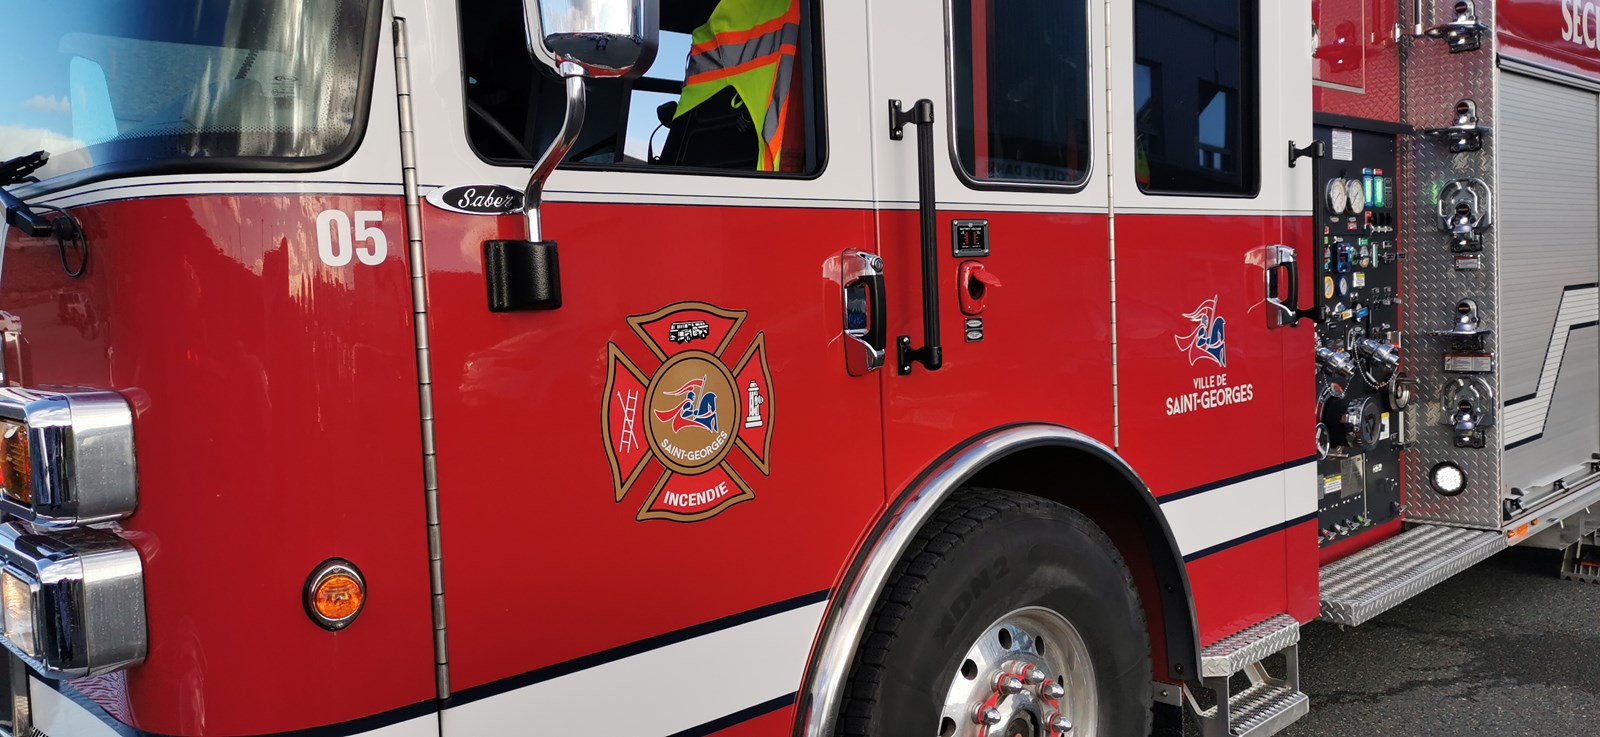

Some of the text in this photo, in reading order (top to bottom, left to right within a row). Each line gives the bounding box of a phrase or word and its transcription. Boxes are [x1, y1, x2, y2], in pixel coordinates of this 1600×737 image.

[457, 188, 513, 208] Saber
[315, 208, 388, 267] 05
[1193, 373, 1227, 389] VILLE DE
[1166, 384, 1253, 415] SAINT-GEORGES
[660, 430, 728, 461] SAINT-GEORGES
[663, 481, 729, 507] INCENDIE
